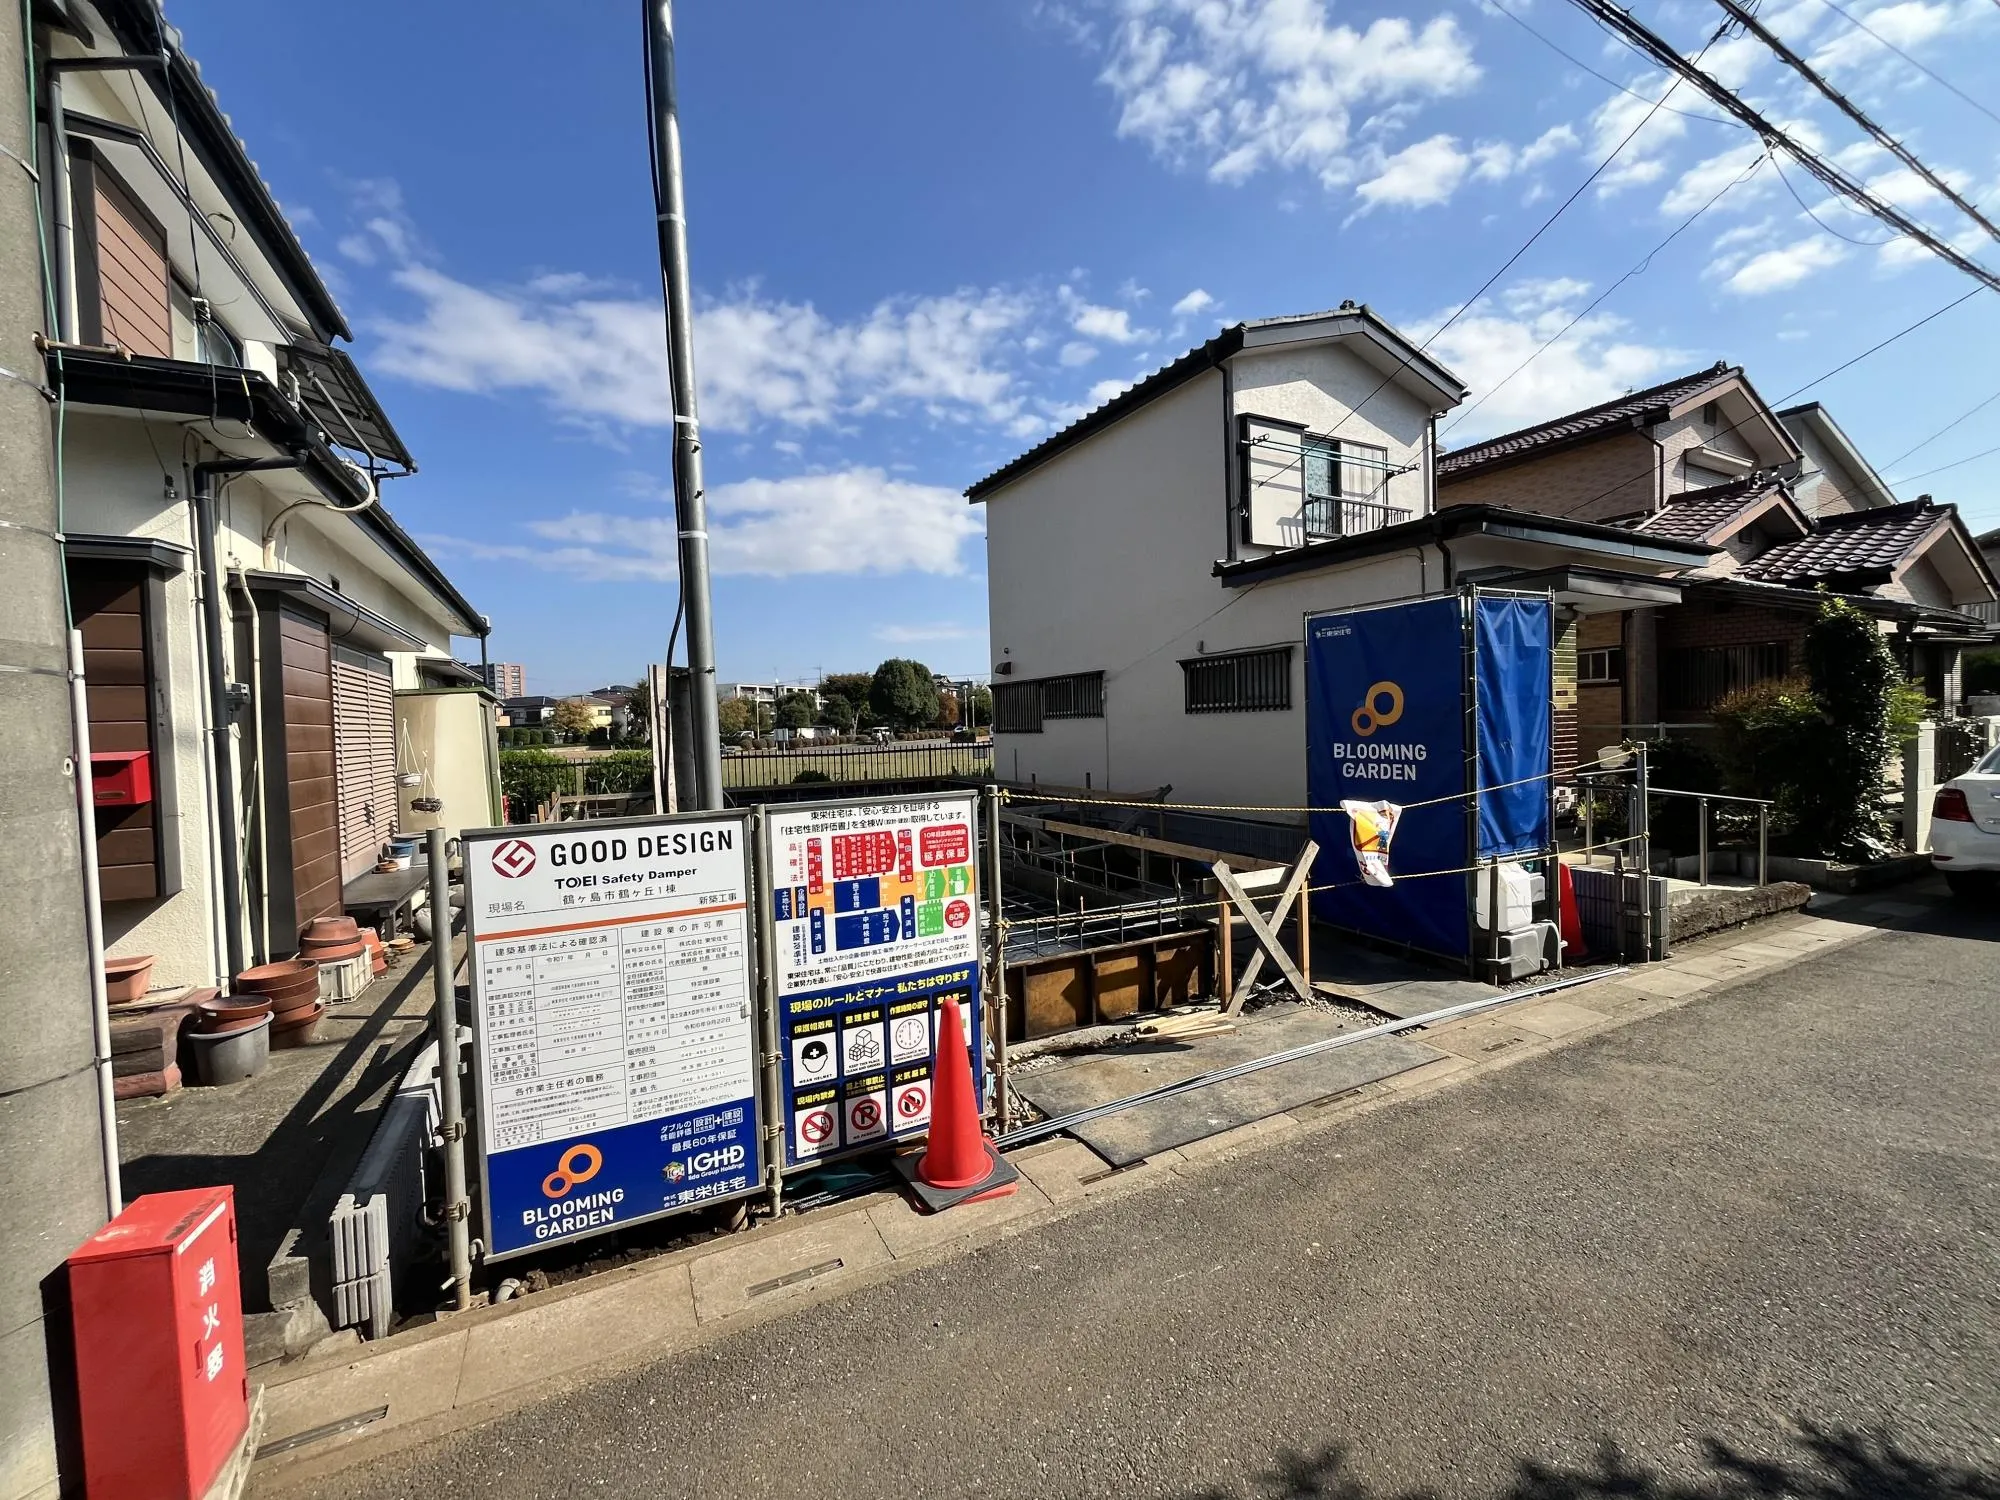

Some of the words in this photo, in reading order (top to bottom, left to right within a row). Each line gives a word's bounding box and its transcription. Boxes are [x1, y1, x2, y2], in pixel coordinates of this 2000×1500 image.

[1333, 743, 1427, 761] BLOOMING
[1342, 762, 1416, 781] GARDEN
[810, 802, 940, 820] 東栄住宅は、「安心・安全」を証明する
[550, 839, 627, 867] GOOD
[638, 829, 733, 858] DESIGN
[924, 848, 965, 861] 延長保証
[602, 873, 644, 885] Safety
[648, 868, 697, 880] Damper
[489, 900, 525, 913] 現場名
[699, 892, 737, 905] 新築工事
[641, 920, 723, 937] 建設業の許可票
[495, 935, 607, 956] 建築基準法による確認済
[790, 987, 894, 1013] 現場のルールとマナー
[897, 970, 969, 993] 私たちは守ります
[628, 1045, 655, 1055] 販売担当
[629, 1058, 655, 1068] 連絡先
[515, 1073, 603, 1096] 各作業主任者の職務
[629, 1071, 656, 1082] 工事担当
[630, 1085, 656, 1095] 連絡先
[695, 1115, 712, 1127] 設計
[724, 1109, 740, 1120] 建設
[660, 1128, 691, 1141] 性能評価
[661, 1121, 691, 1133] ダブルの
[672, 1129, 736, 1152] 最長60年保証
[688, 1145, 744, 1174] IGHD
[701, 1169, 719, 1177] Group
[720, 1162, 744, 1172] Holdings
[677, 1176, 746, 1204] 東栄住宅
[523, 1188, 623, 1225] BLOOMING
[536, 1207, 613, 1238] GARDEN
[197, 1256, 224, 1382] 消火器
